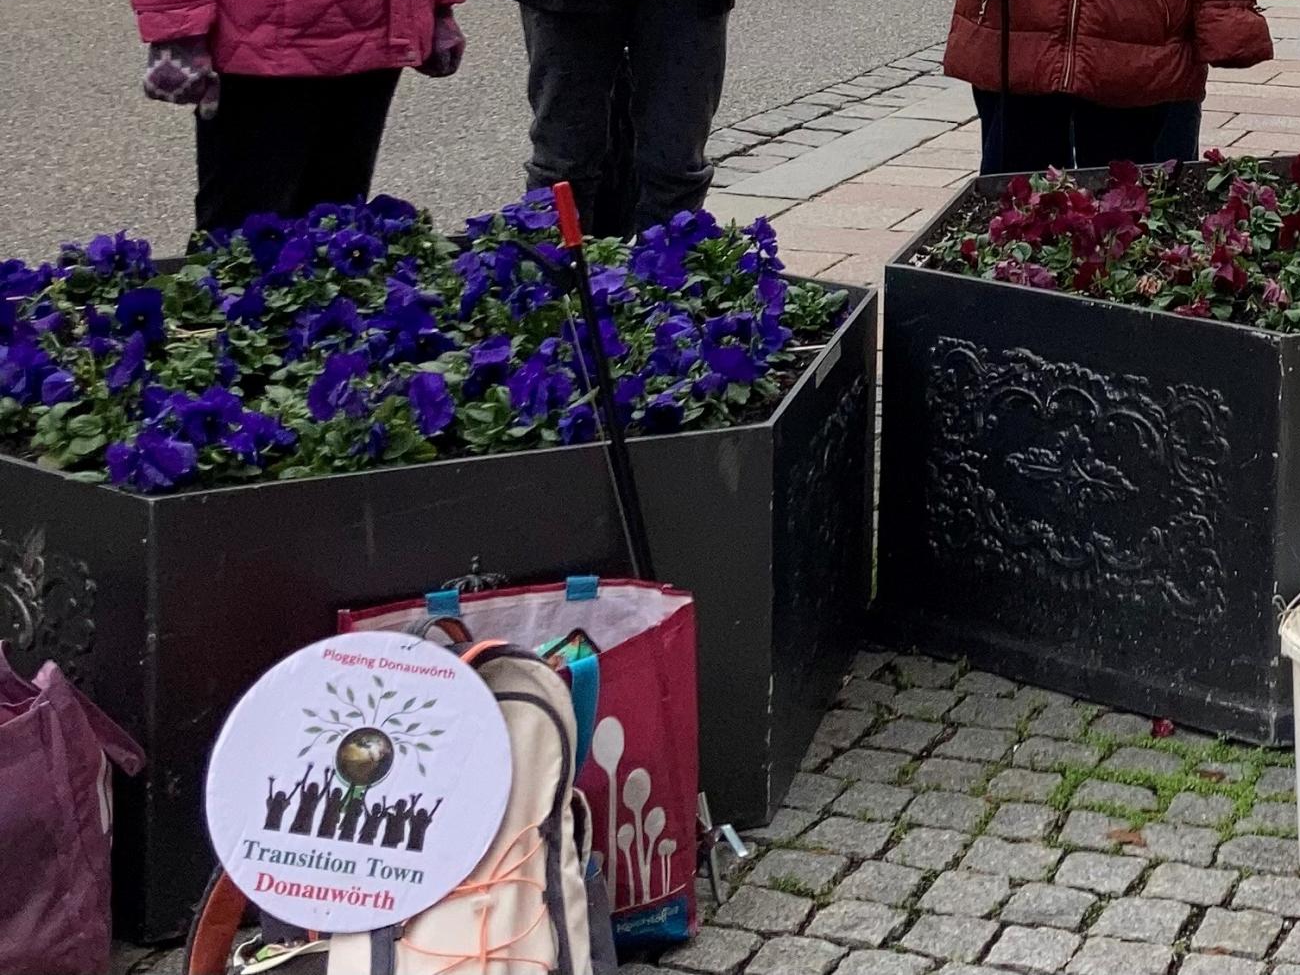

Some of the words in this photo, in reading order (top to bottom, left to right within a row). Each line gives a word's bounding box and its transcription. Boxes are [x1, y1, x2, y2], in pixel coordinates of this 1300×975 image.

[322, 647, 376, 669] Plogging
[378, 657, 456, 680] Donauwörth
[243, 839, 357, 875] Transition
[366, 857, 425, 885] Town
[254, 872, 396, 911] Donauwörth
